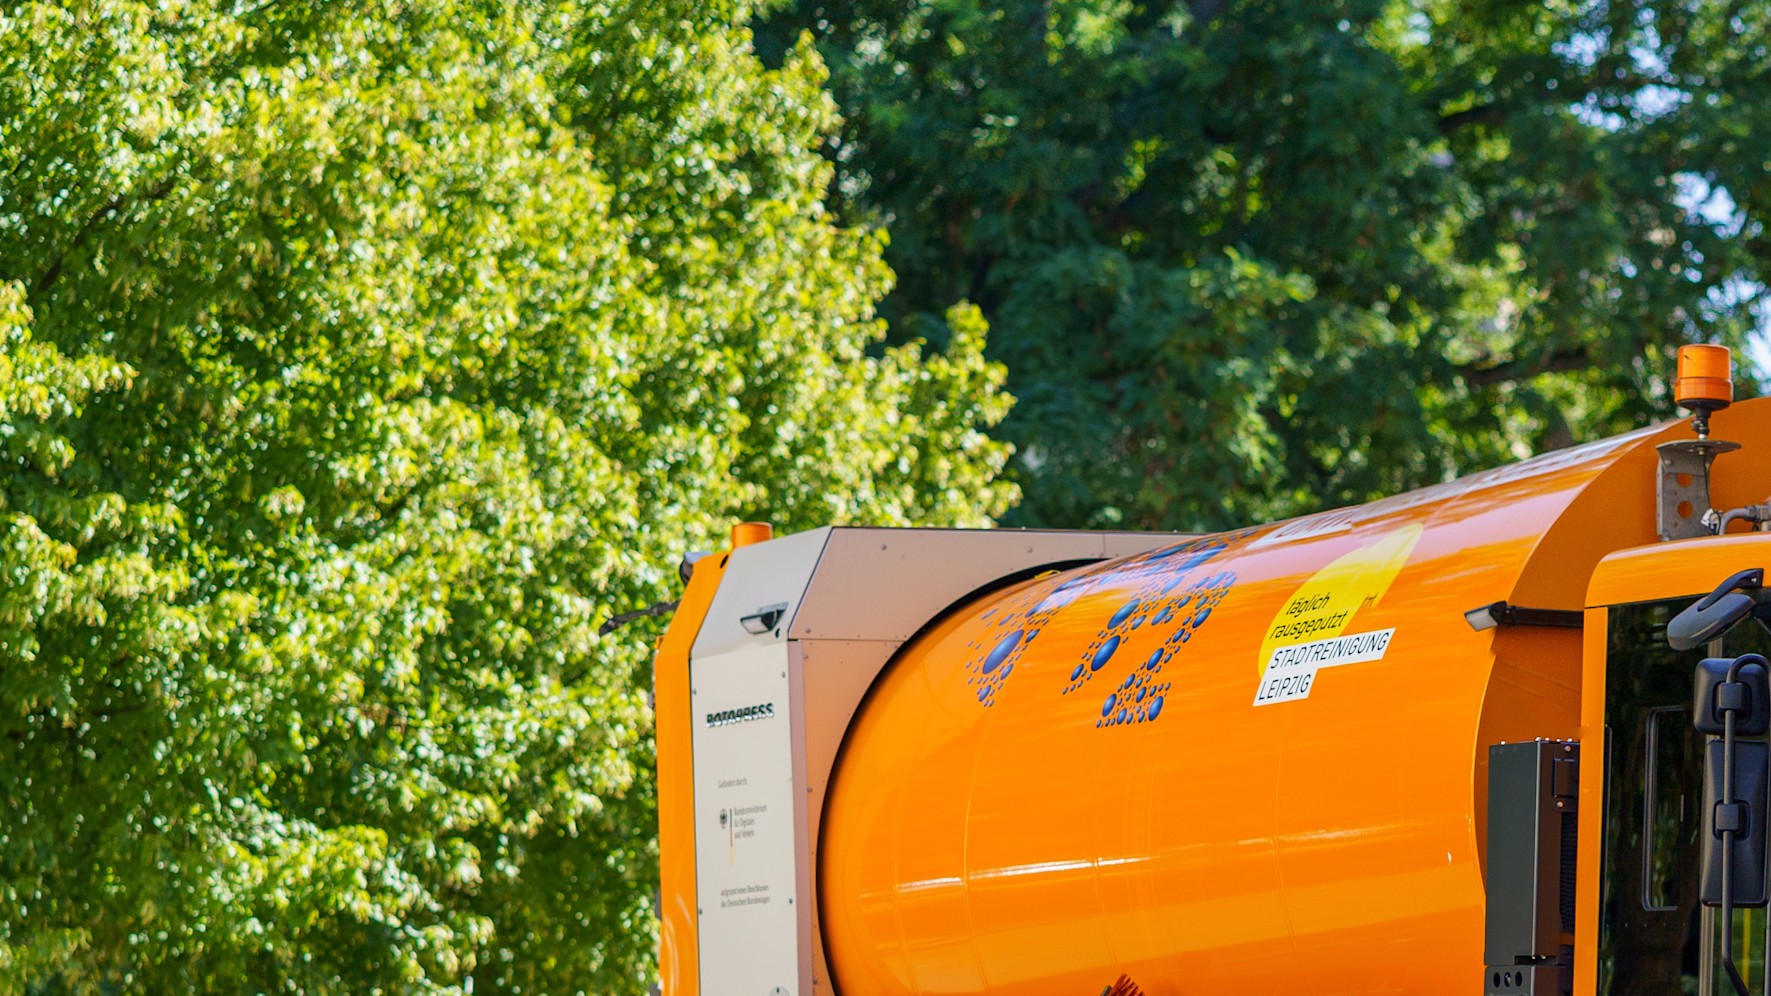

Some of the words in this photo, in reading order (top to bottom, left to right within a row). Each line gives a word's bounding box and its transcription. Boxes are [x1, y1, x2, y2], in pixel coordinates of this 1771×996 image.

[1286, 592, 1331, 618] täglich
[1269, 610, 1349, 640] rausgeputzt
[1270, 631, 1390, 669] STADTREINIGUNG
[1258, 673, 1312, 701] LEIPZIG
[706, 702, 775, 728] ROTOPRESS
